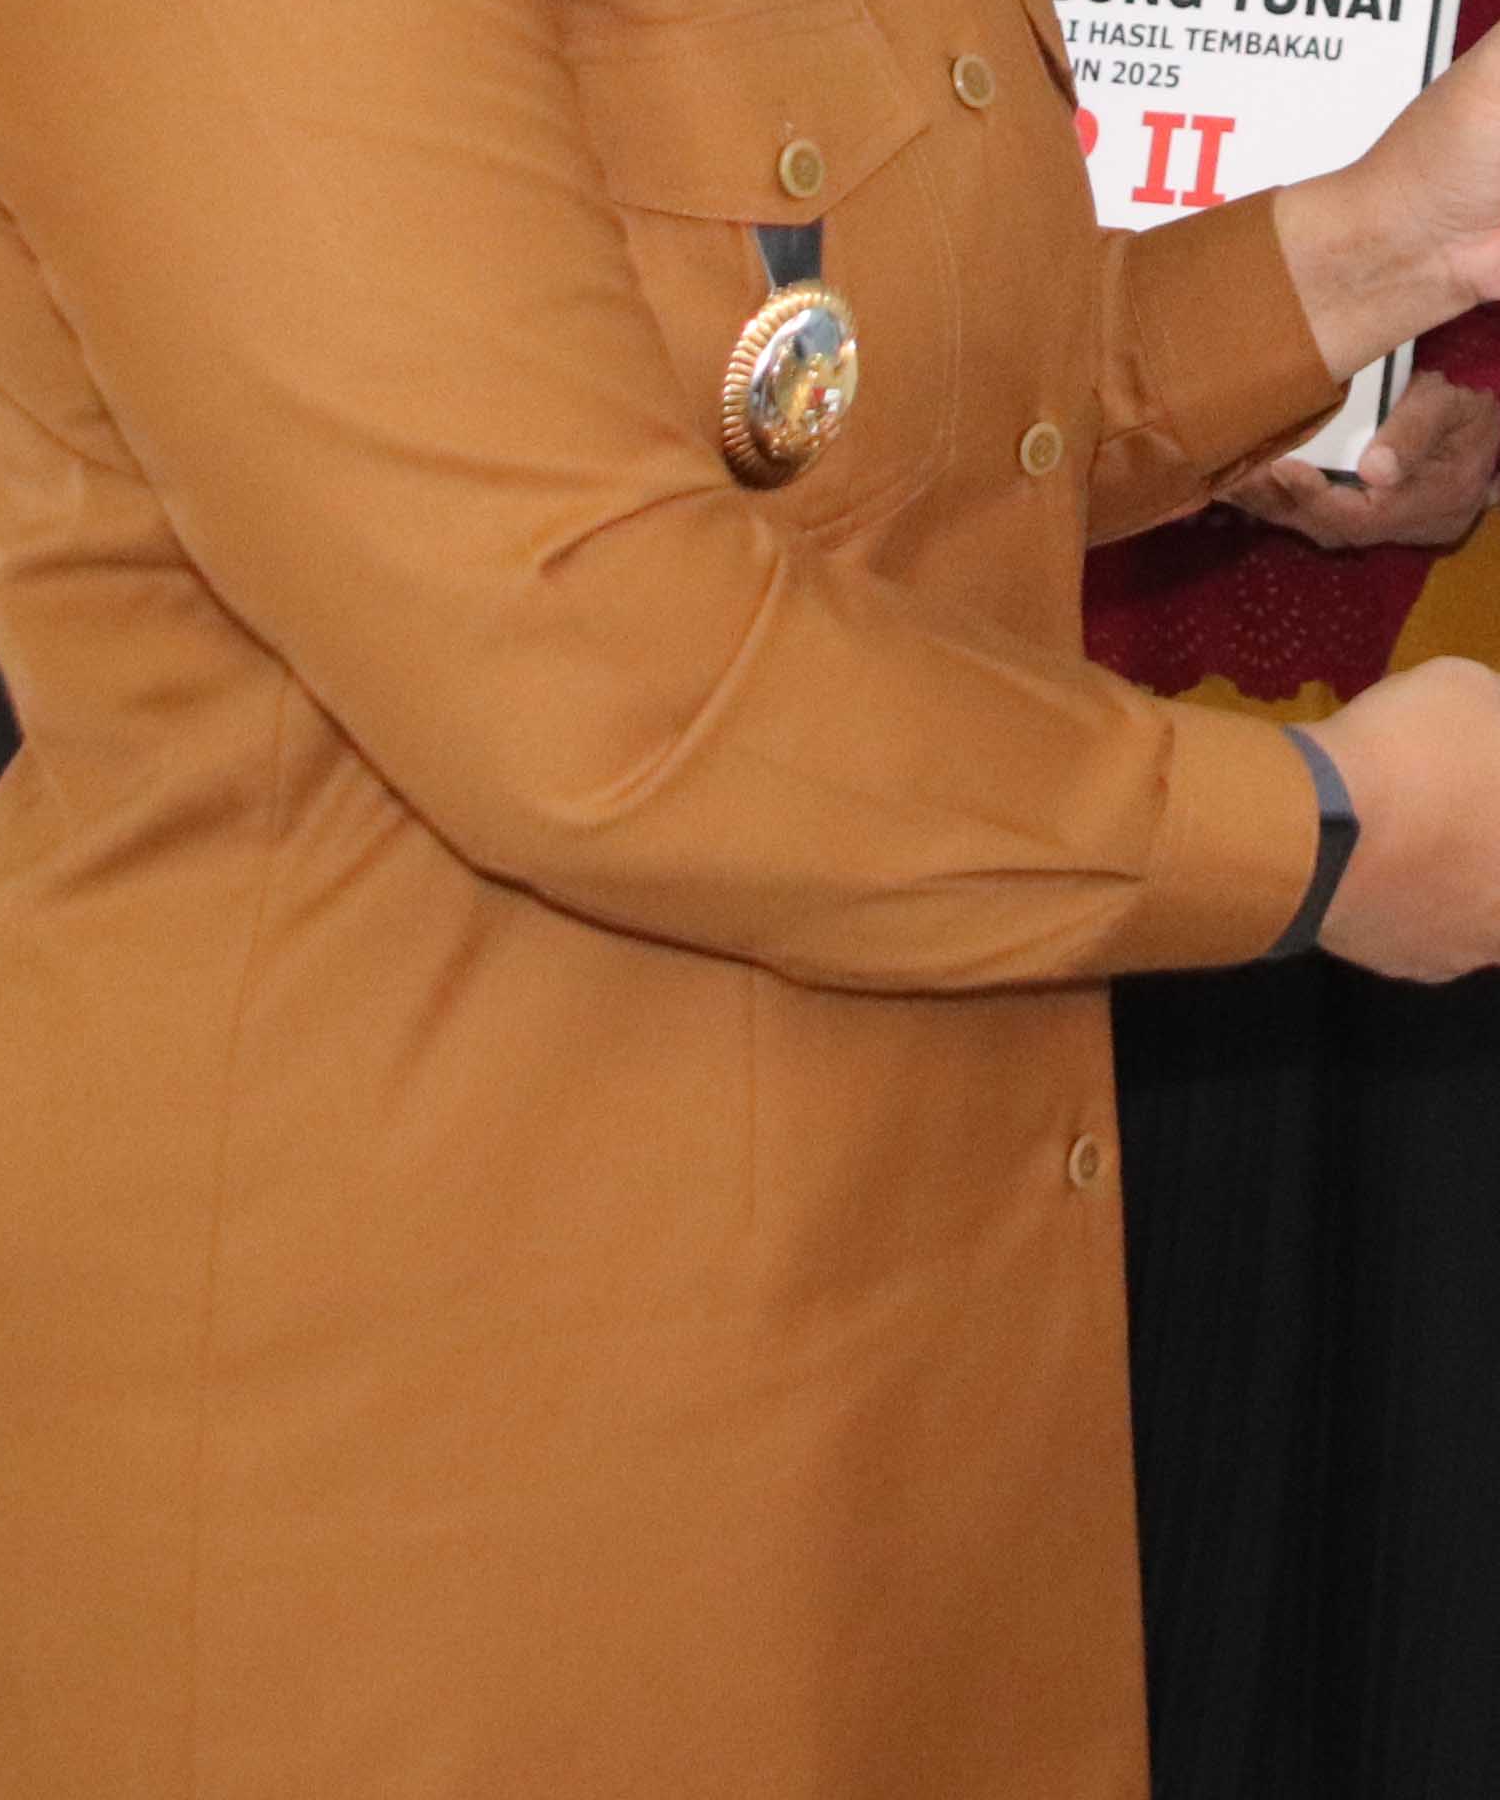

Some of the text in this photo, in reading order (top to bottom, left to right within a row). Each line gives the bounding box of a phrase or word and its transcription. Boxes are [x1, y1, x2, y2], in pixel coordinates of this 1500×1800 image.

[1088, 20, 1175, 50] HASIL
[1184, 27, 1344, 62] TEMBAKAU
[1111, 61, 1181, 89] 2025
[1130, 110, 1237, 209] II
